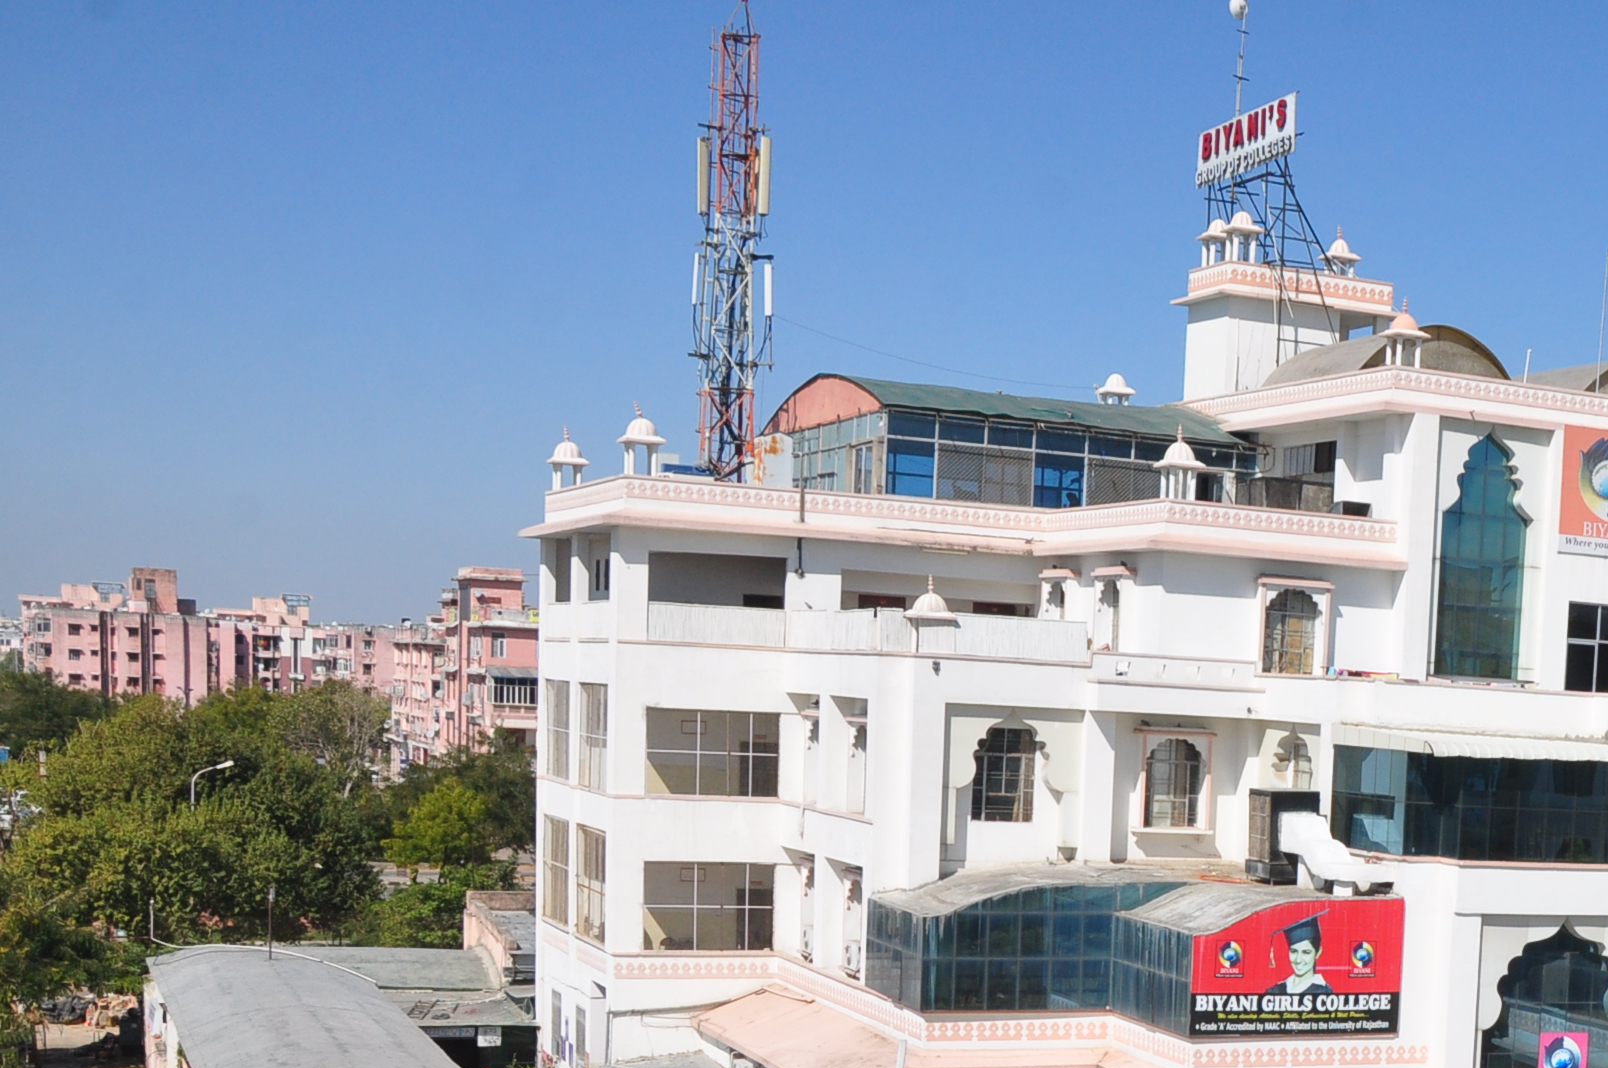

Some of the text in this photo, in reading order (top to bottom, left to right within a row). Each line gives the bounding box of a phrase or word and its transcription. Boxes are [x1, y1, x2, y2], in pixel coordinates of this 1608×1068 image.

[1201, 99, 1288, 162] BIYANI'S
[1195, 136, 1292, 186] GROUP OF COLLEGES
[1564, 537, 1592, 548] Where
[1195, 993, 1391, 1012] BIYANI GIRLS COLLEGE
